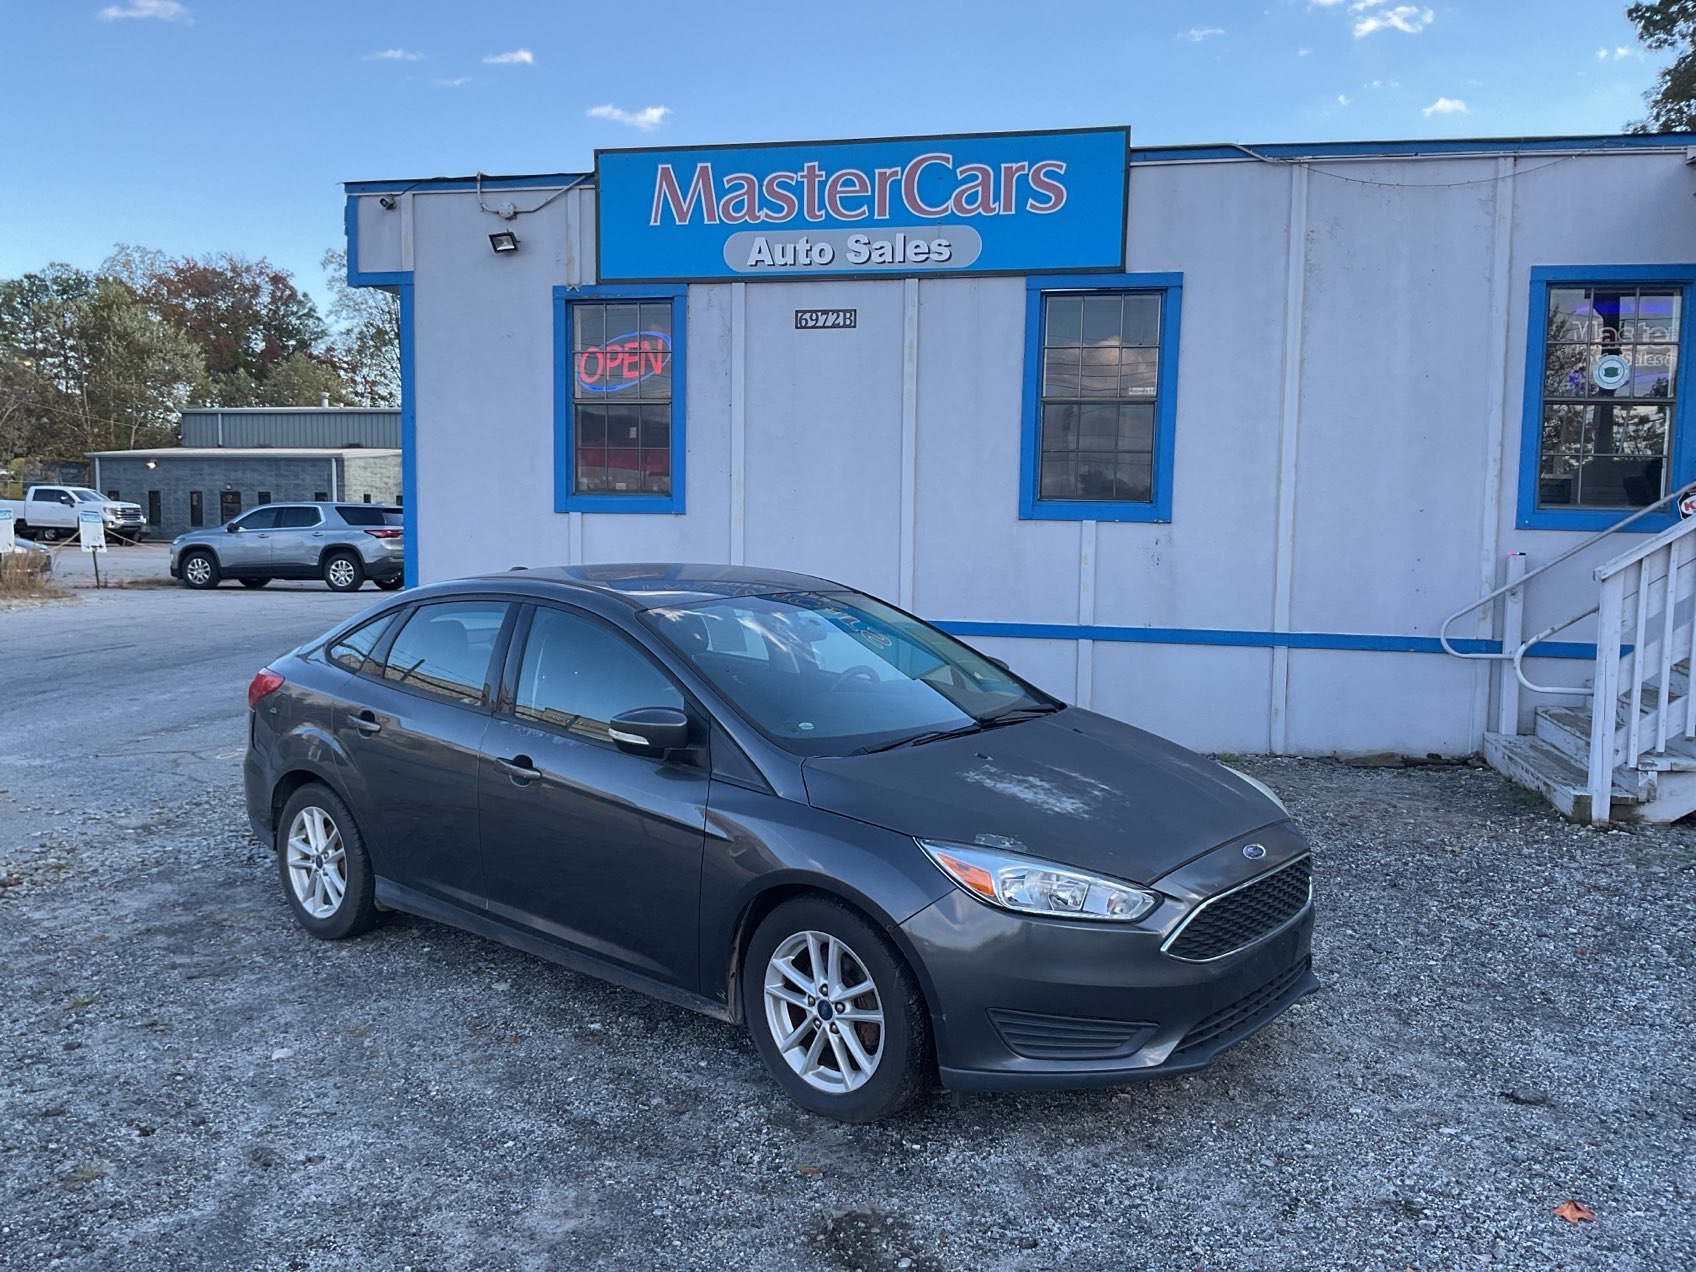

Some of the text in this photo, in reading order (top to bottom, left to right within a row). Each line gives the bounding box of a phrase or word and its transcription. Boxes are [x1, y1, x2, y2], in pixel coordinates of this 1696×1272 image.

[649, 153, 1068, 227] MasterCars
[747, 232, 953, 267] Auto Sales
[797, 310, 855, 328] 6972B
[578, 336, 663, 384] OPEN
